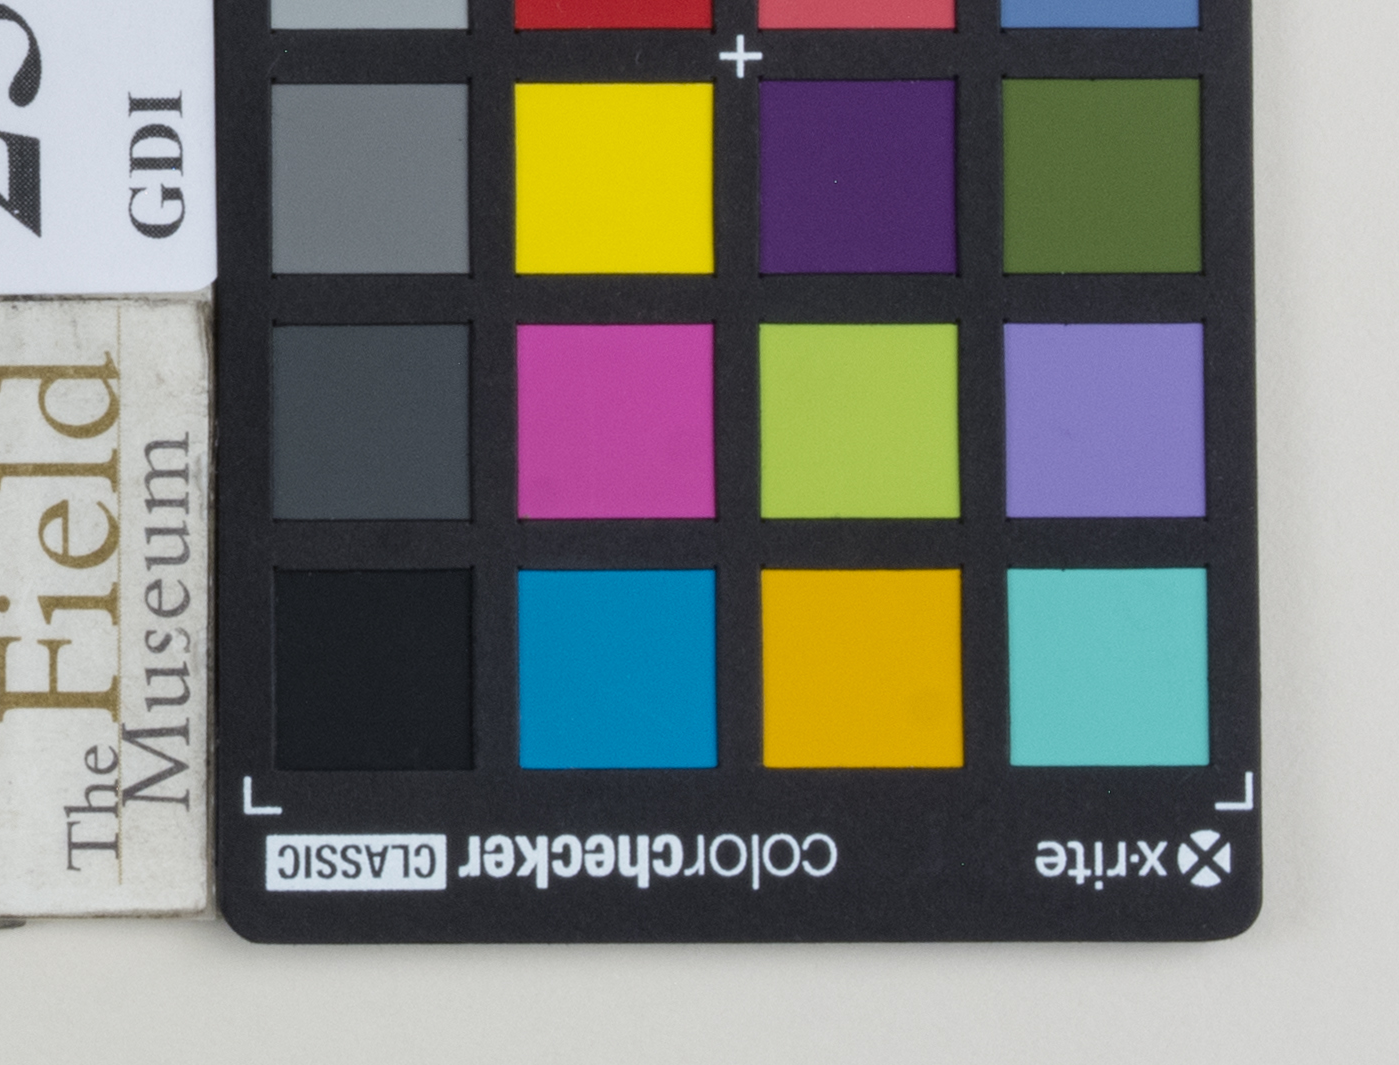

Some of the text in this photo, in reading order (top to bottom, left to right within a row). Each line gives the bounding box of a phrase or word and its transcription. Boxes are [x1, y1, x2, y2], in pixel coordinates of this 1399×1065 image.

[127, 90, 187, 241] GDI
[121, 431, 192, 814] Museum
[63, 744, 120, 872] The
[277, 833, 839, 892] colorchecker CLASSIC
